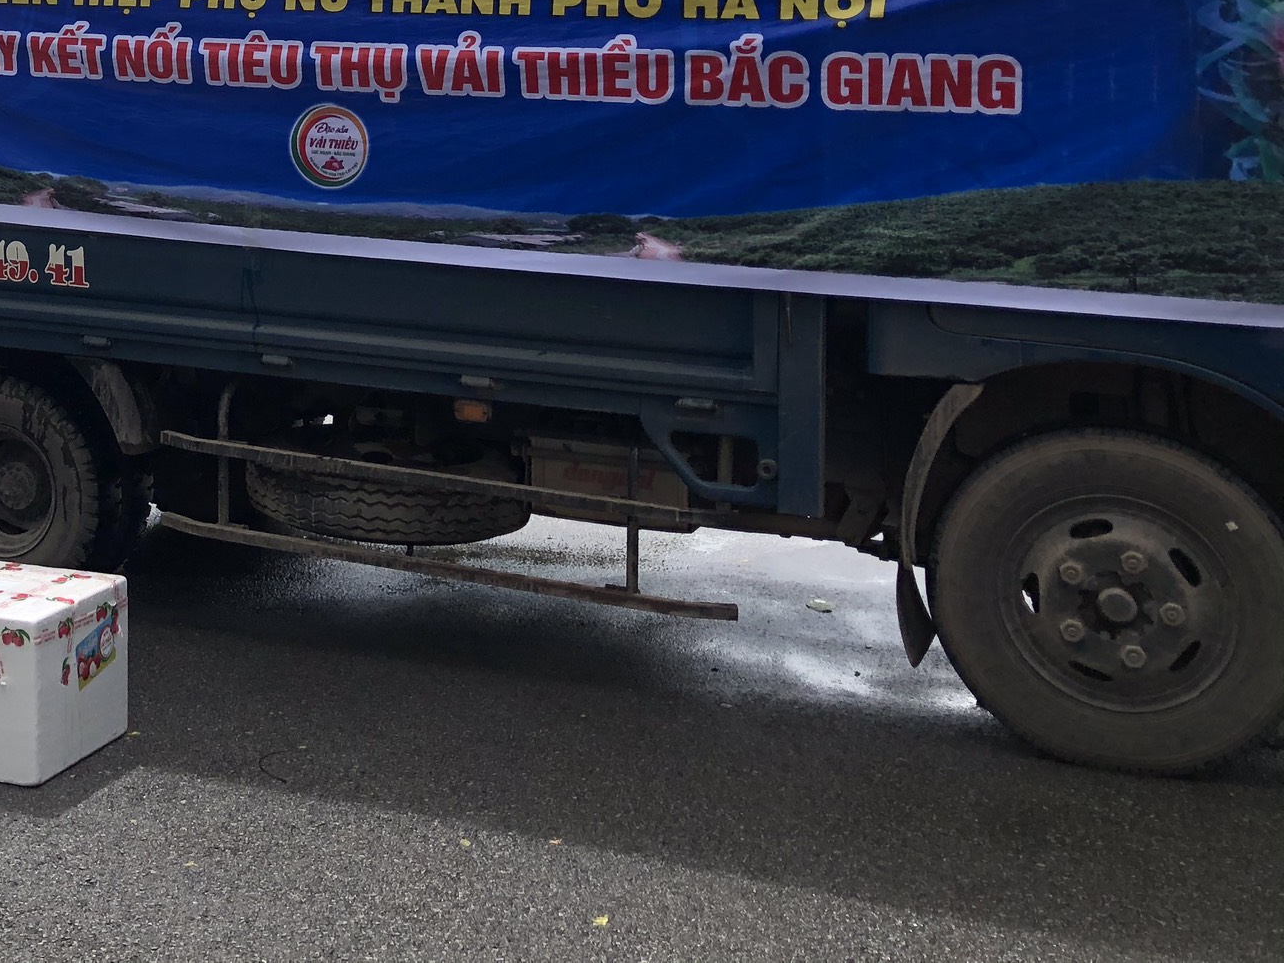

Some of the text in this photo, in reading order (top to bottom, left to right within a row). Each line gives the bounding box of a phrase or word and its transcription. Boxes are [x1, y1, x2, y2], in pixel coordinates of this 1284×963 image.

[28, 22, 105, 78] KẾT
[114, 23, 191, 82] NỐI
[201, 31, 302, 88] TIÊU
[311, 42, 406, 102] THỤ
[417, 31, 504, 96] VẢI
[514, 36, 673, 103] THIỀU
[686, 35, 808, 107] BẮC
[822, 52, 1021, 113] GIANG
